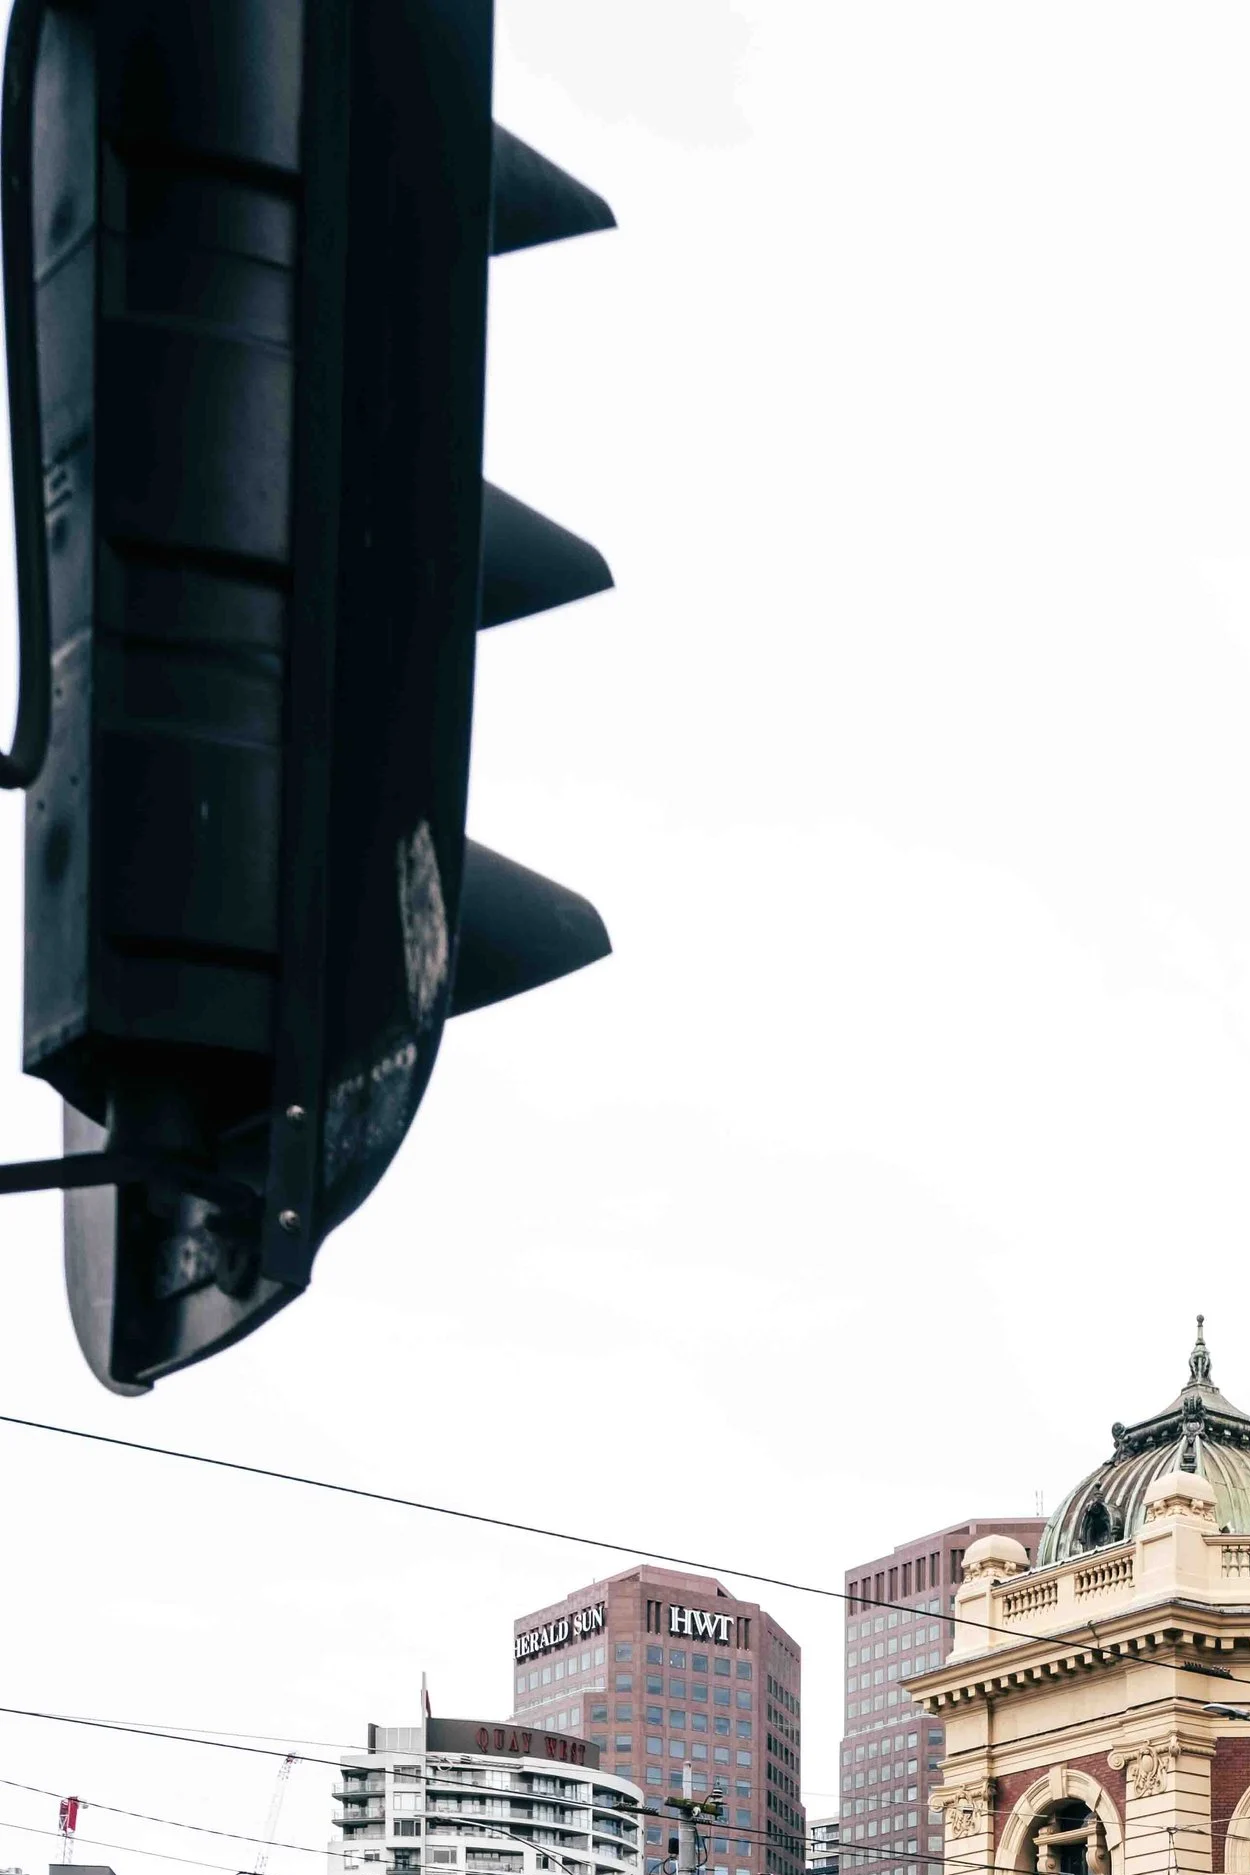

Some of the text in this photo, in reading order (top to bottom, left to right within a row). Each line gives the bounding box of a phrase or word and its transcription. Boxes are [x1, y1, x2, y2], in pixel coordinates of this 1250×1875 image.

[513, 1606, 604, 1659] HERALD SUN
[670, 1606, 734, 1641] HWT
[476, 1727, 585, 1766] QUAY WEST
